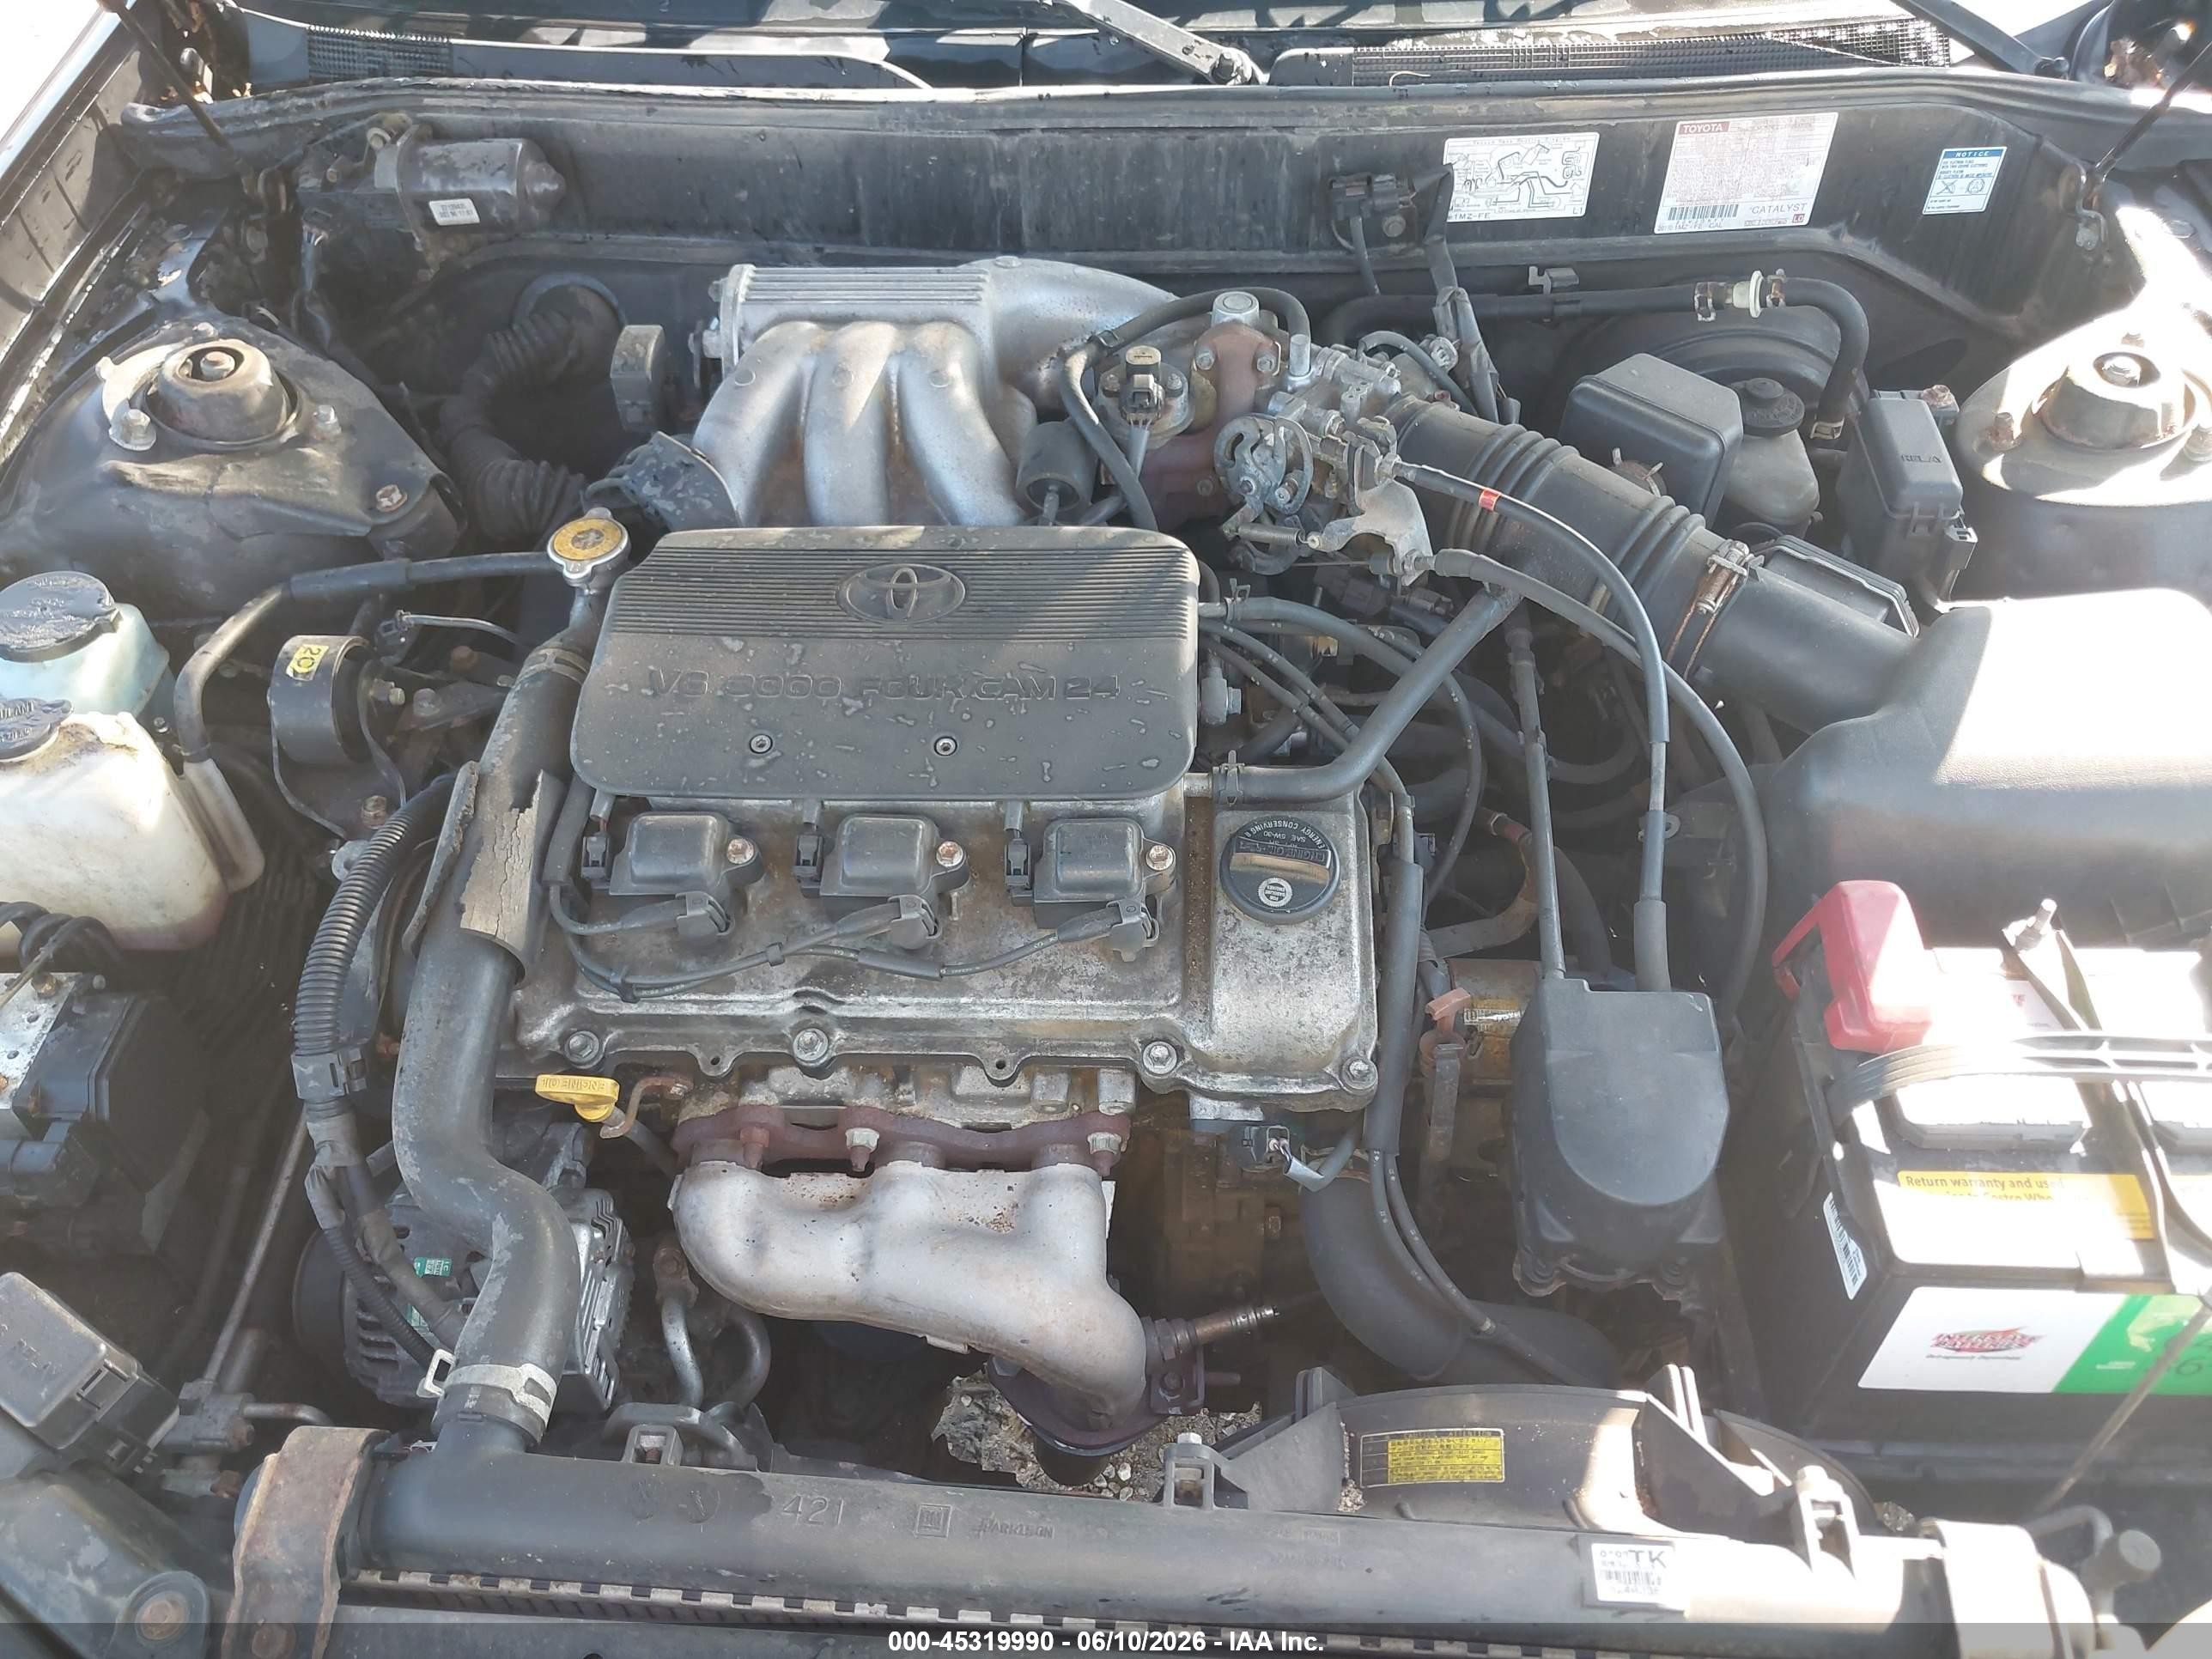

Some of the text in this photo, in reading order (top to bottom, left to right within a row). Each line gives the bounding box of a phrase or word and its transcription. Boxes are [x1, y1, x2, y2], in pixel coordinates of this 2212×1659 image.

[1682, 123, 1724, 133] TOYOTA
[1751, 203, 1808, 214] CATALYST
[726, 672, 842, 699] 3000
[861, 675, 964, 700] FOUR
[972, 675, 1057, 701] CAM
[1065, 675, 1121, 701] 24
[1250, 820, 1298, 835] CONSERVING
[1291, 834, 1306, 842] SAE
[1300, 825, 1326, 849] ENERGY
[541, 1078, 605, 1091] ENGINE OIL
[1905, 1176, 1948, 1188] Return
[1950, 1177, 2005, 1190] warranty
[2008, 1177, 2033, 1188] and
[781, 1494, 845, 1527] 421
